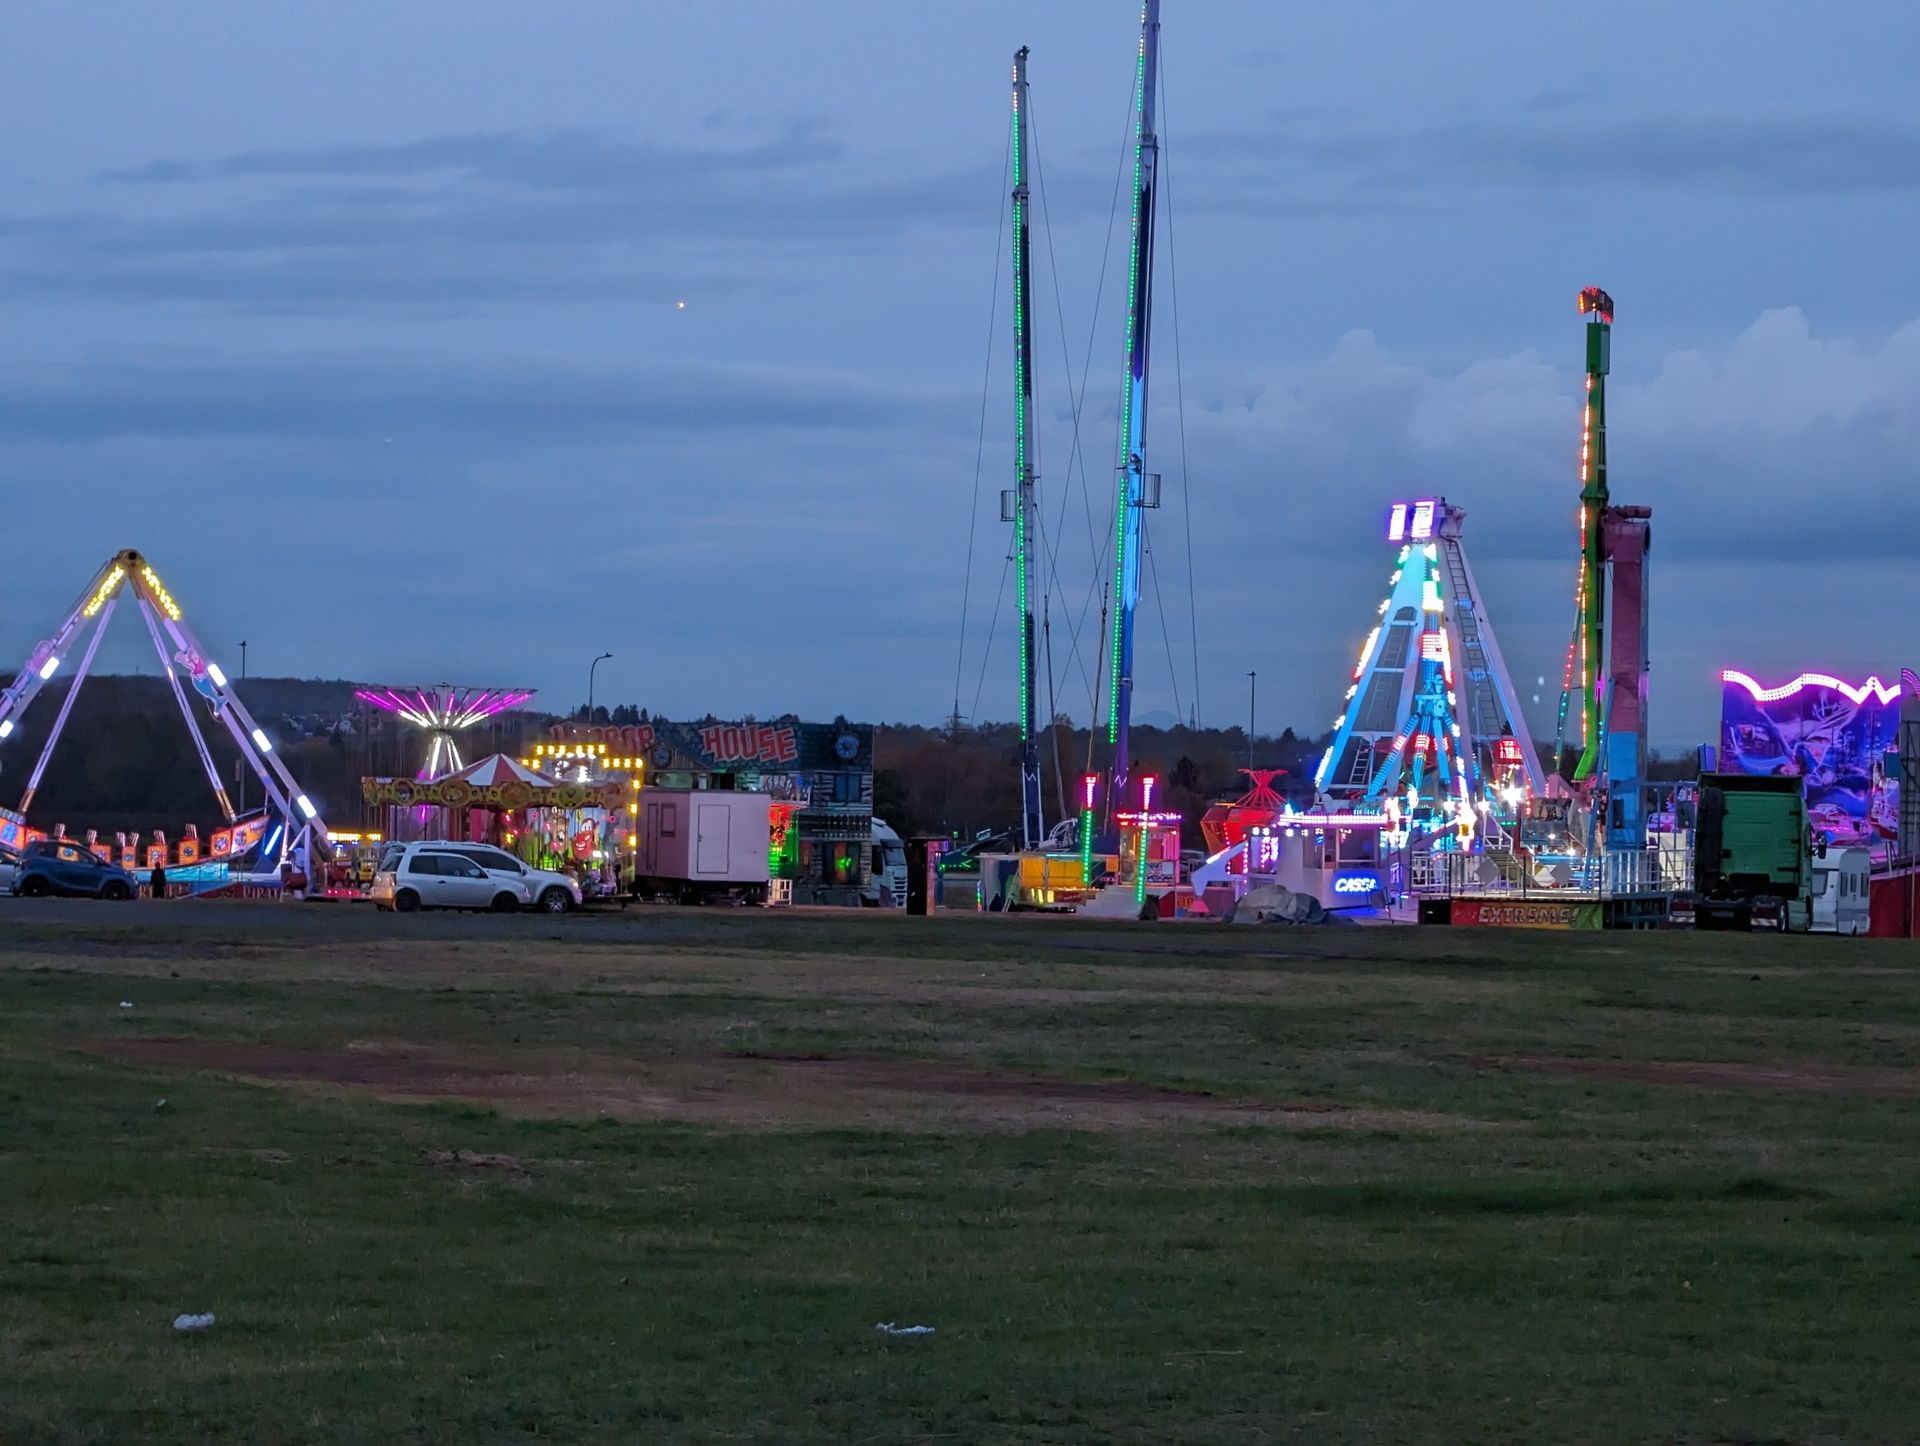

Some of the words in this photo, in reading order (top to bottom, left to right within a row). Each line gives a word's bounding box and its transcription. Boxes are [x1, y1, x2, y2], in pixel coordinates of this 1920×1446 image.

[550, 721, 655, 757] ROR
[698, 724, 799, 764] HOUSE
[243, 885, 288, 900] PIRAT
[1478, 905, 1581, 927] EXTREME!
